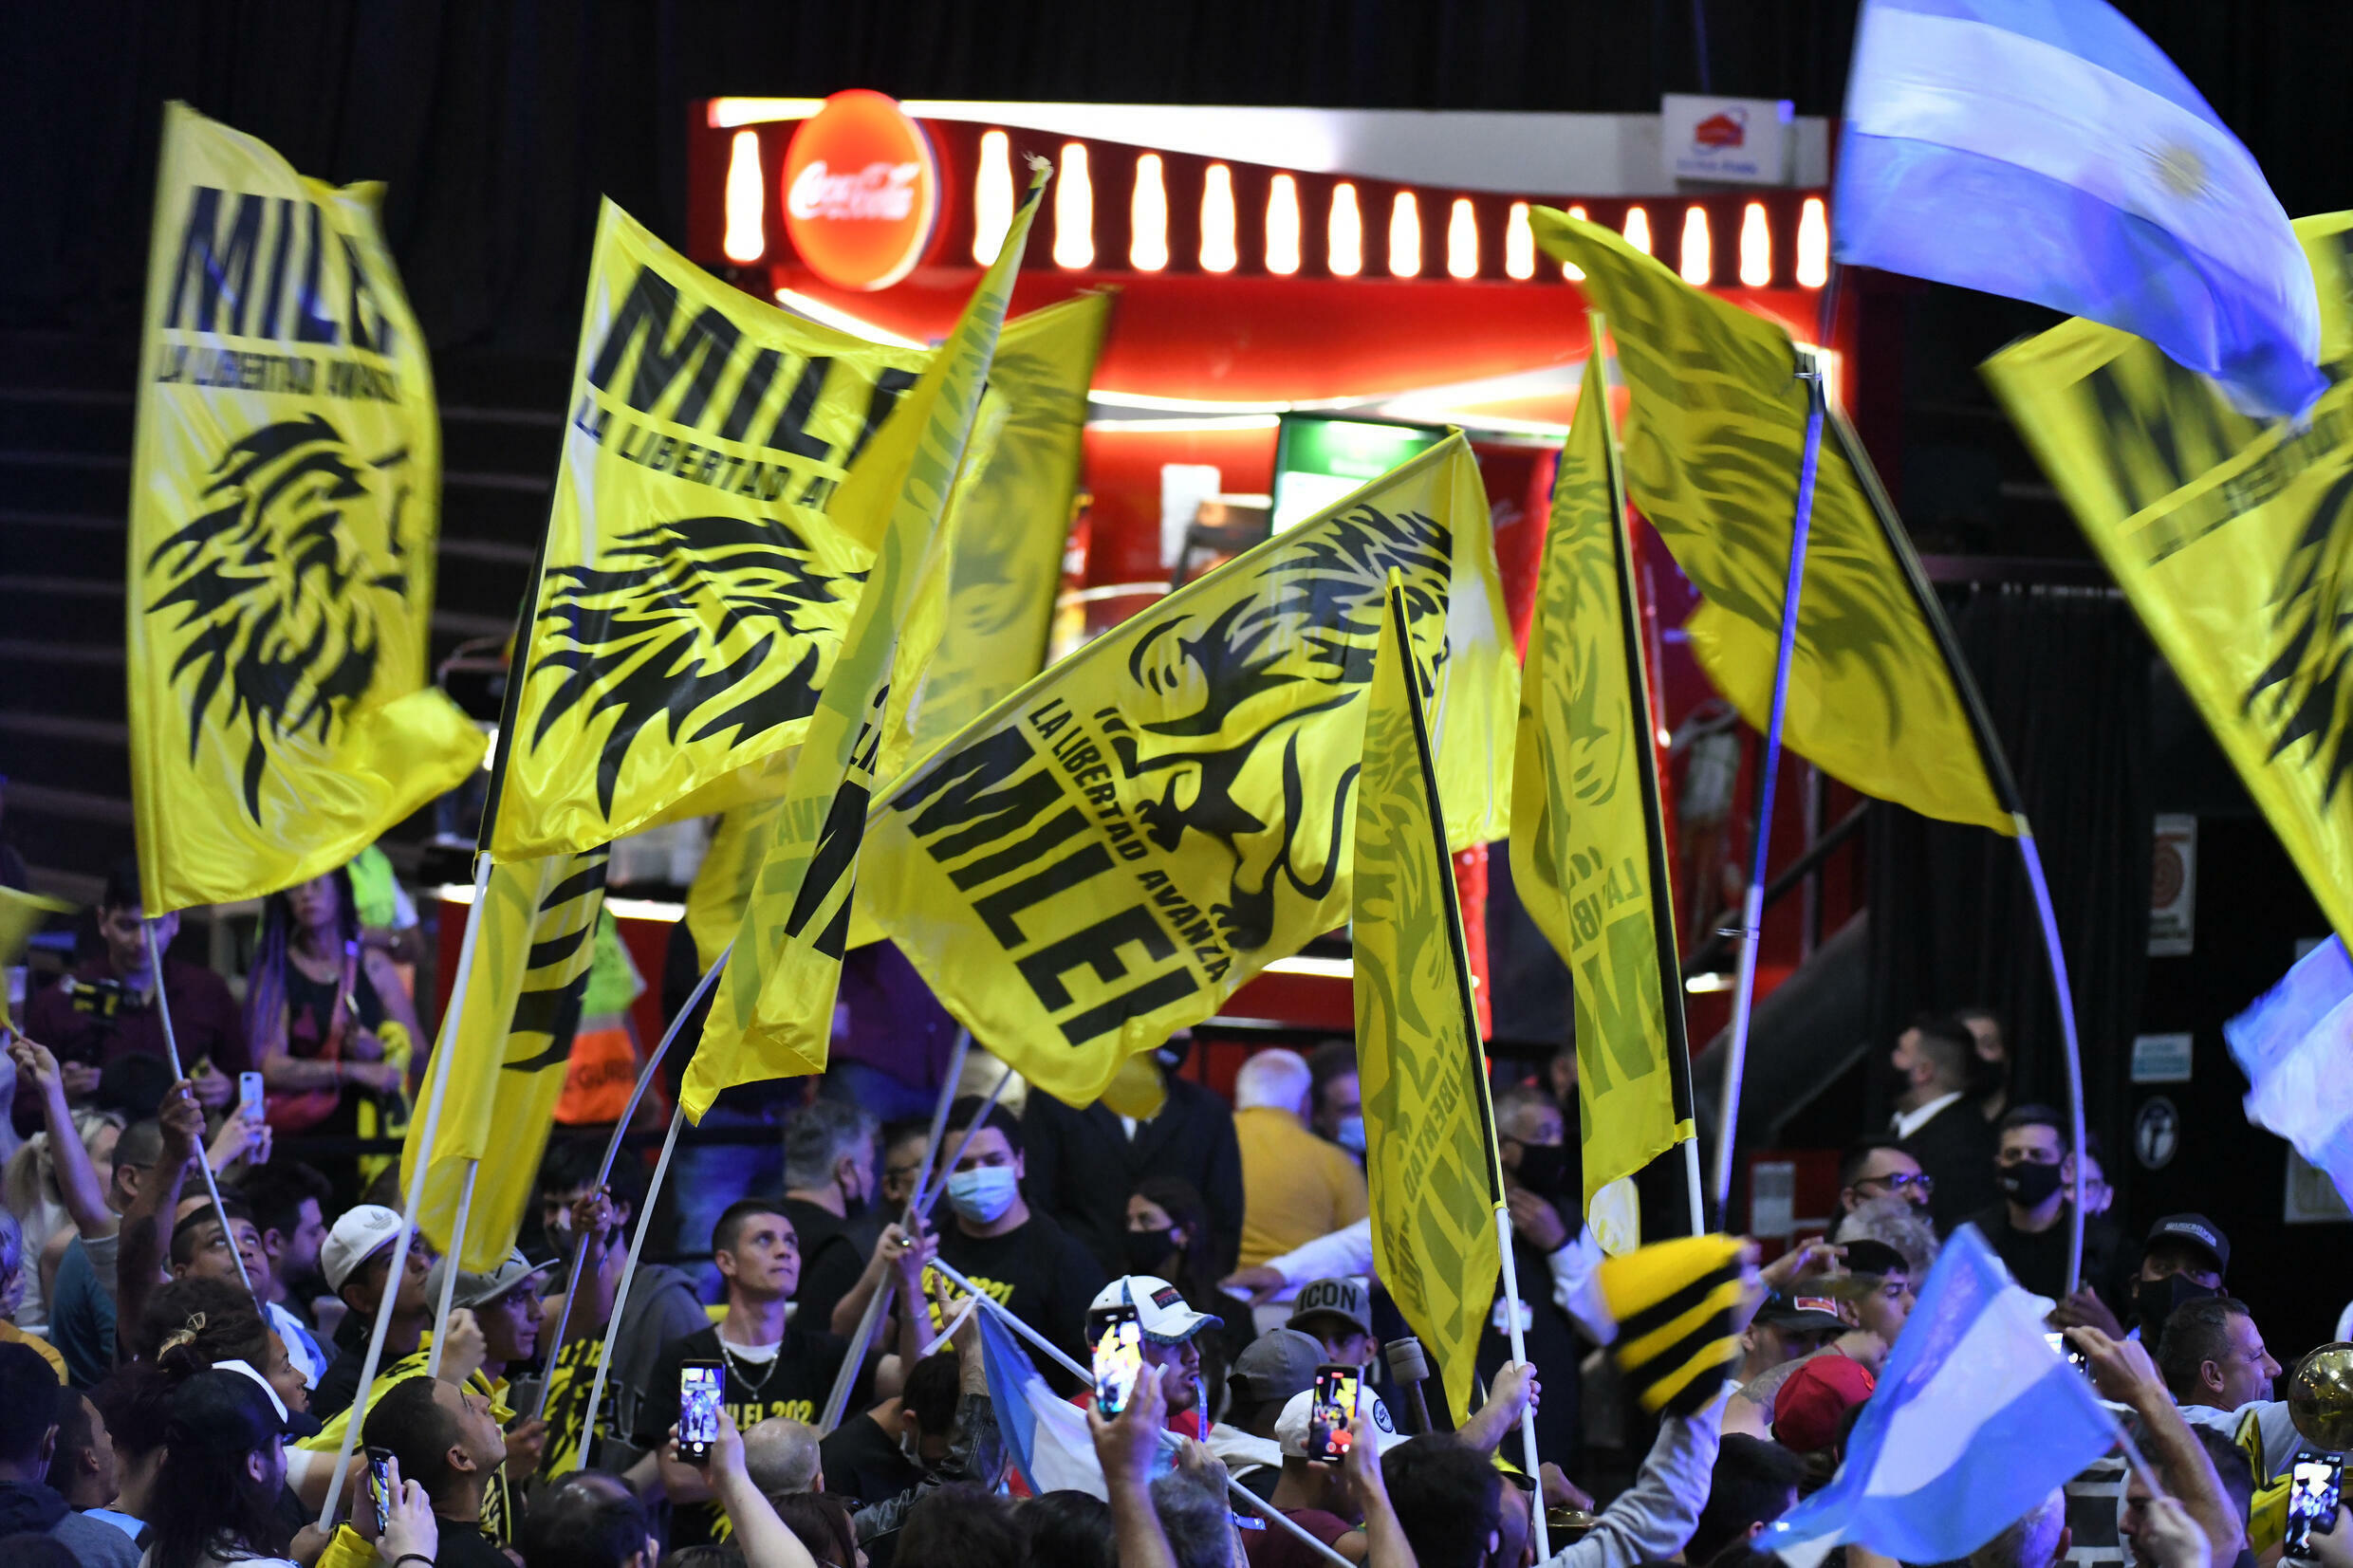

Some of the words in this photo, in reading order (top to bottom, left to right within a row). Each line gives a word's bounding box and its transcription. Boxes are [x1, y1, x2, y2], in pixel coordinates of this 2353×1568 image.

[889, 725, 1201, 1048] MILEI
[1028, 698, 1073, 740] LA
[1051, 726, 1149, 861] LIBERTAD
[1136, 869, 1232, 984] AVANZA
[1299, 1282, 1357, 1314] ICON
